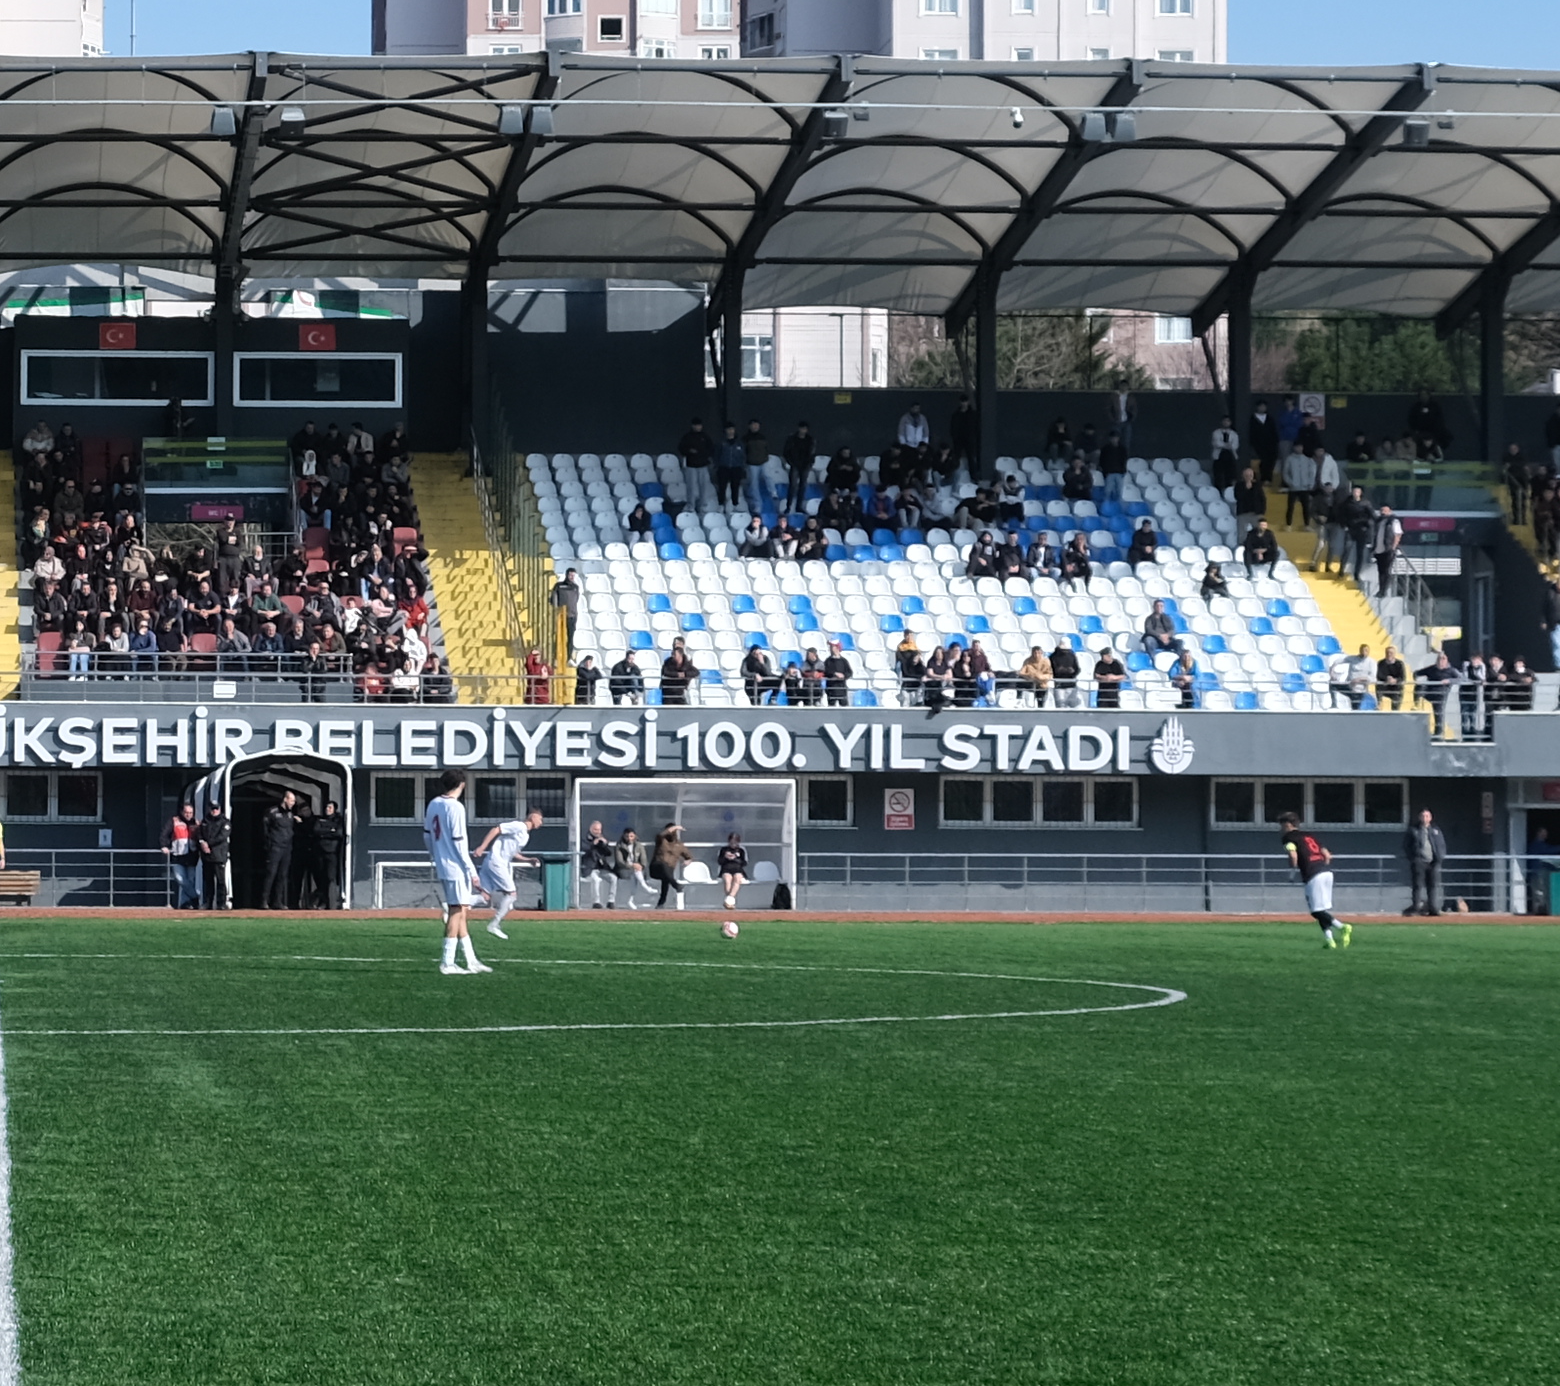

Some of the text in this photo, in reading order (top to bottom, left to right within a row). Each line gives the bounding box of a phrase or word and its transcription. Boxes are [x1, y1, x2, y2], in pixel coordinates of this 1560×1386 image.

[275, 708, 659, 767] BELEDİYESİ
[676, 720, 807, 769] 100.
[823, 722, 926, 770] YIL
[940, 723, 1131, 771] STADI
[1304, 836, 1320, 854] 8
